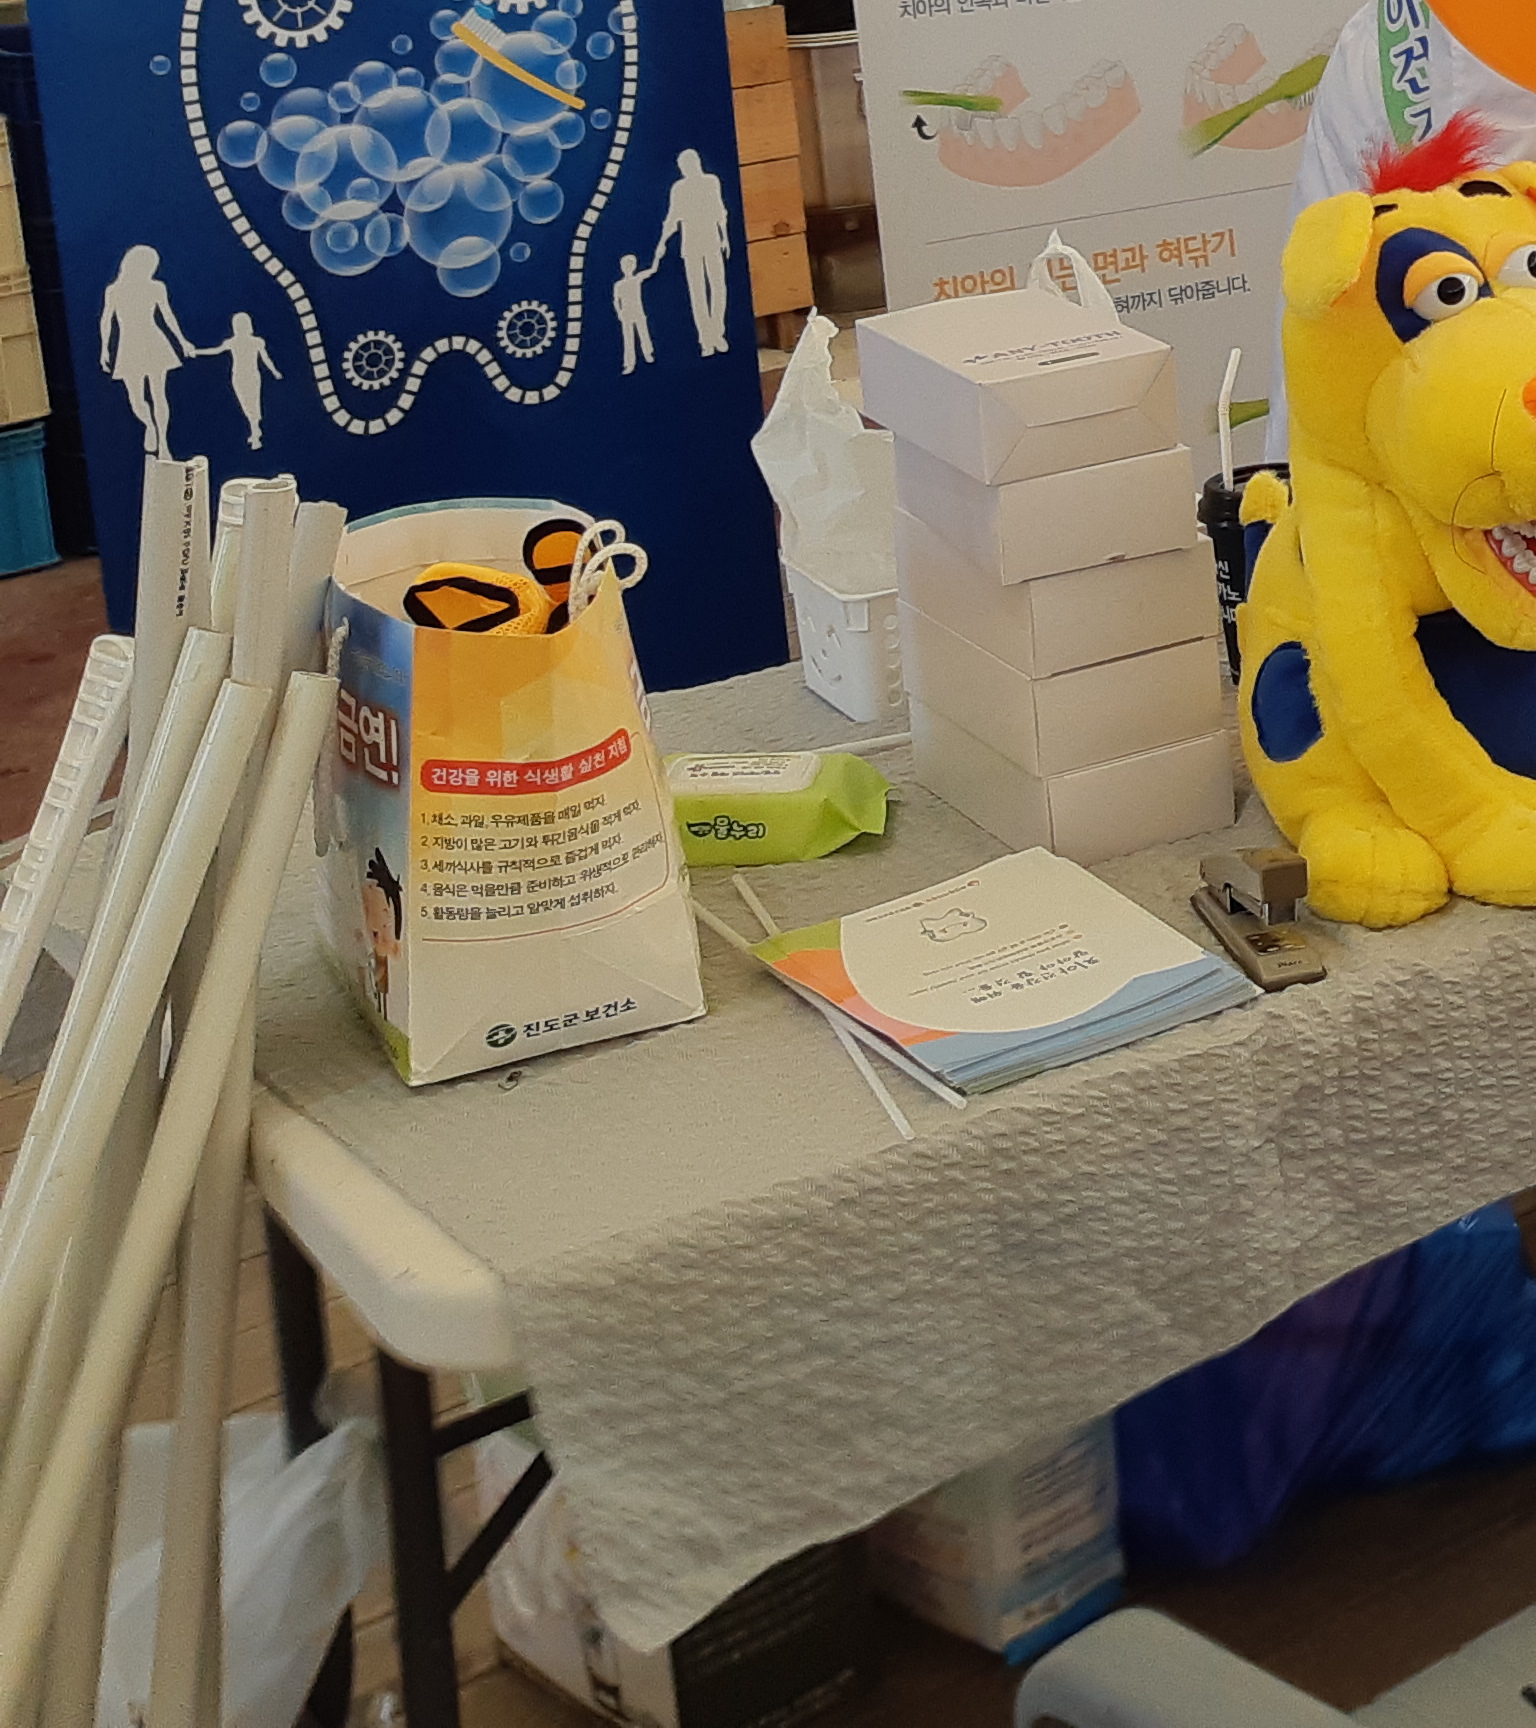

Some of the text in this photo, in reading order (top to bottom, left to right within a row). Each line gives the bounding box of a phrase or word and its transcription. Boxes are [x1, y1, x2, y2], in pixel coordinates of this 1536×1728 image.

[1157, 229, 1238, 269] 혀닦기
[431, 767, 481, 787] 건강을
[485, 769, 520, 789] 위한
